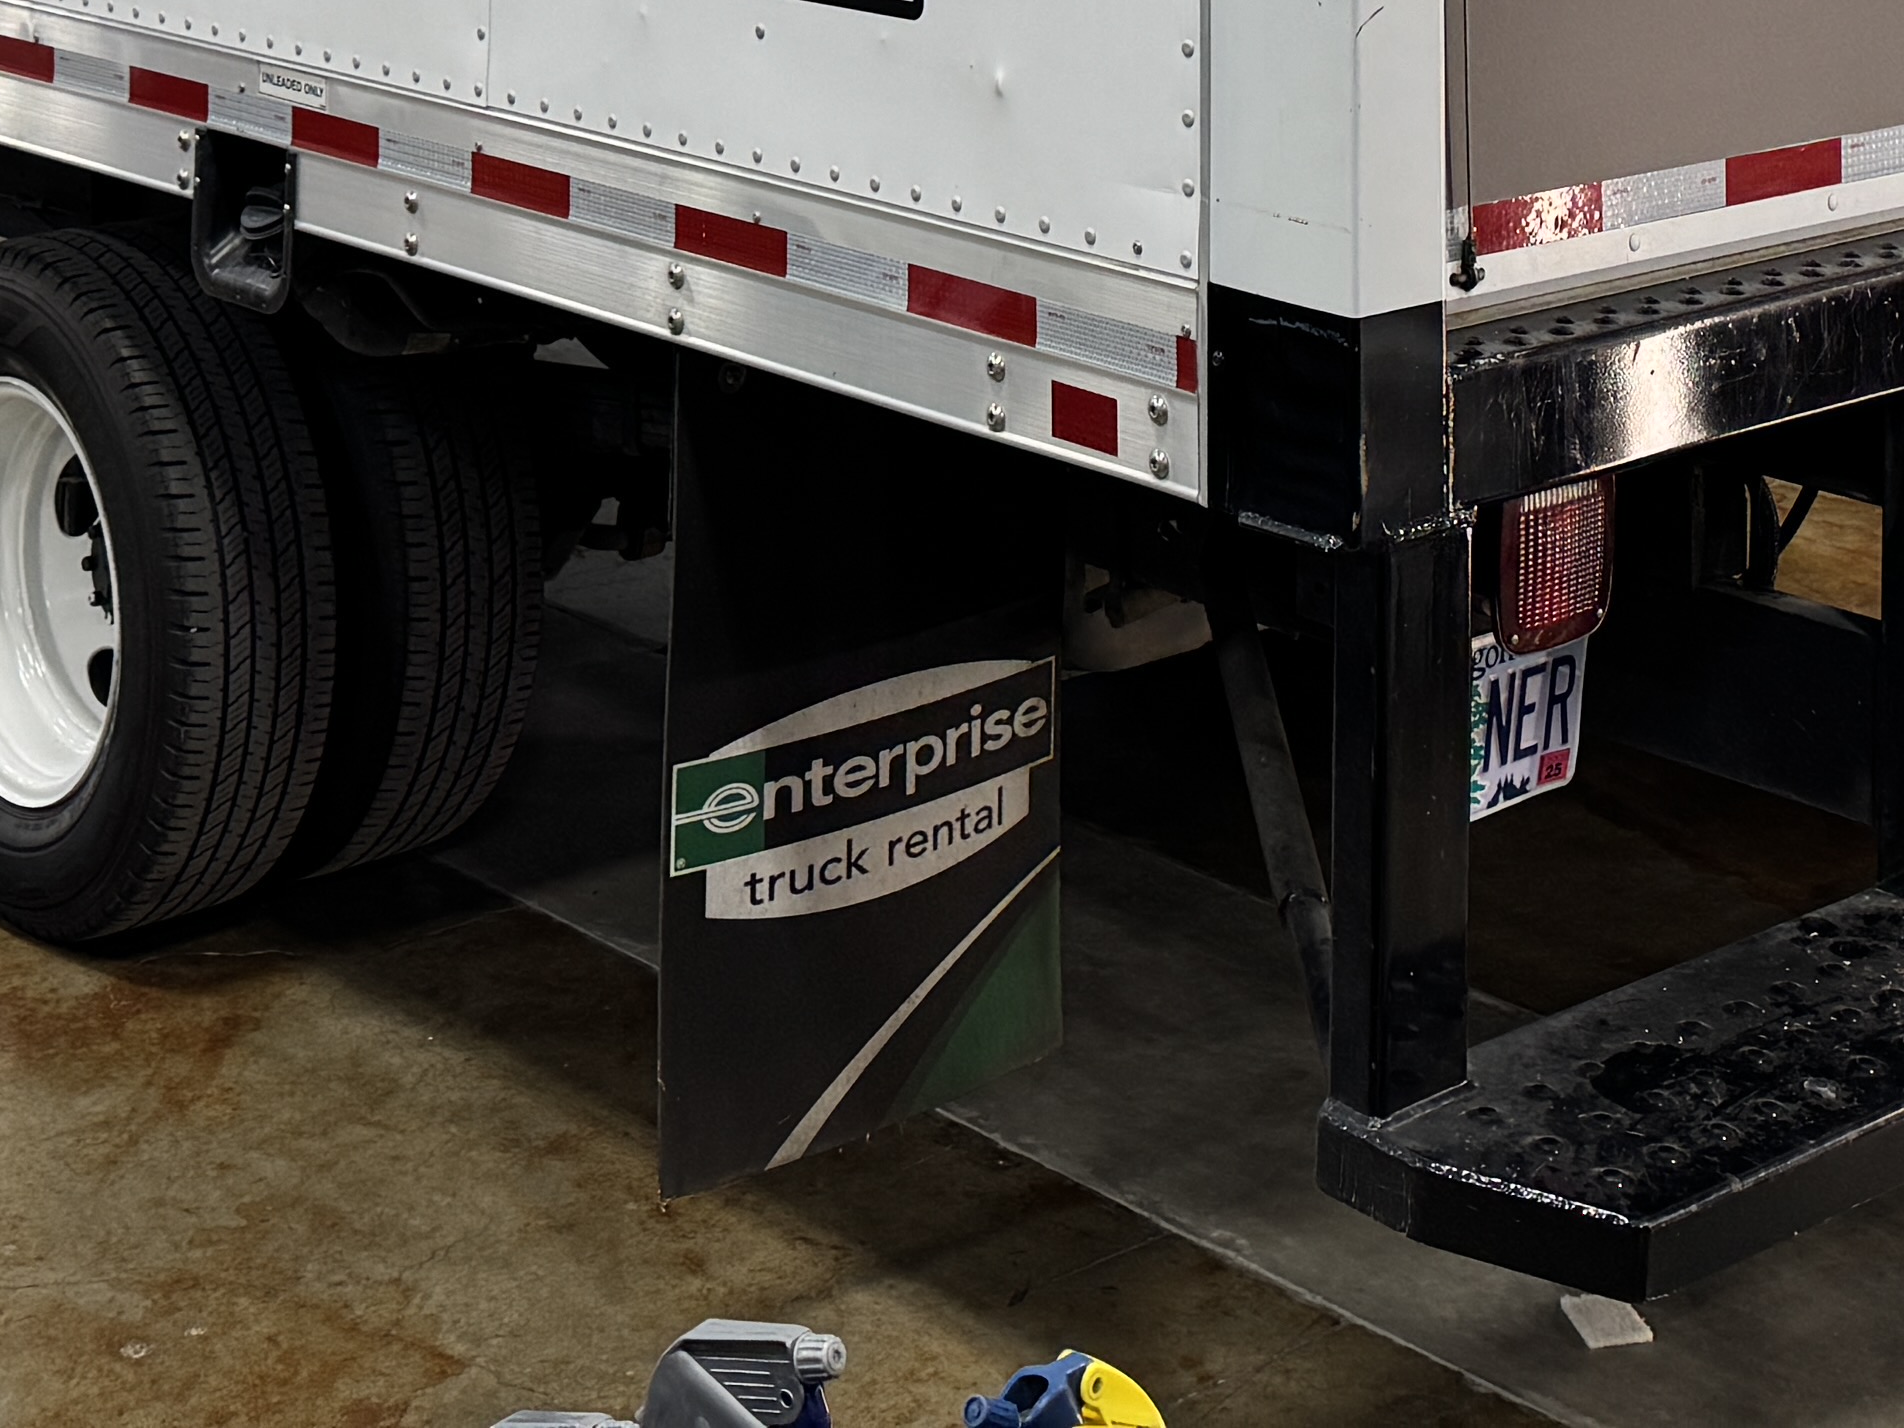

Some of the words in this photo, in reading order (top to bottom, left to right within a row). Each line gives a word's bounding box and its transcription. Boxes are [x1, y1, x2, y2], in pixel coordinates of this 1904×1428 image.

[261, 71, 302, 93] UNLEADED
[303, 82, 324, 98] ONLY
[675, 696, 1048, 834] enterprise
[1482, 654, 1577, 774] NER
[743, 837, 871, 907] truck
[886, 785, 1004, 867] rental
